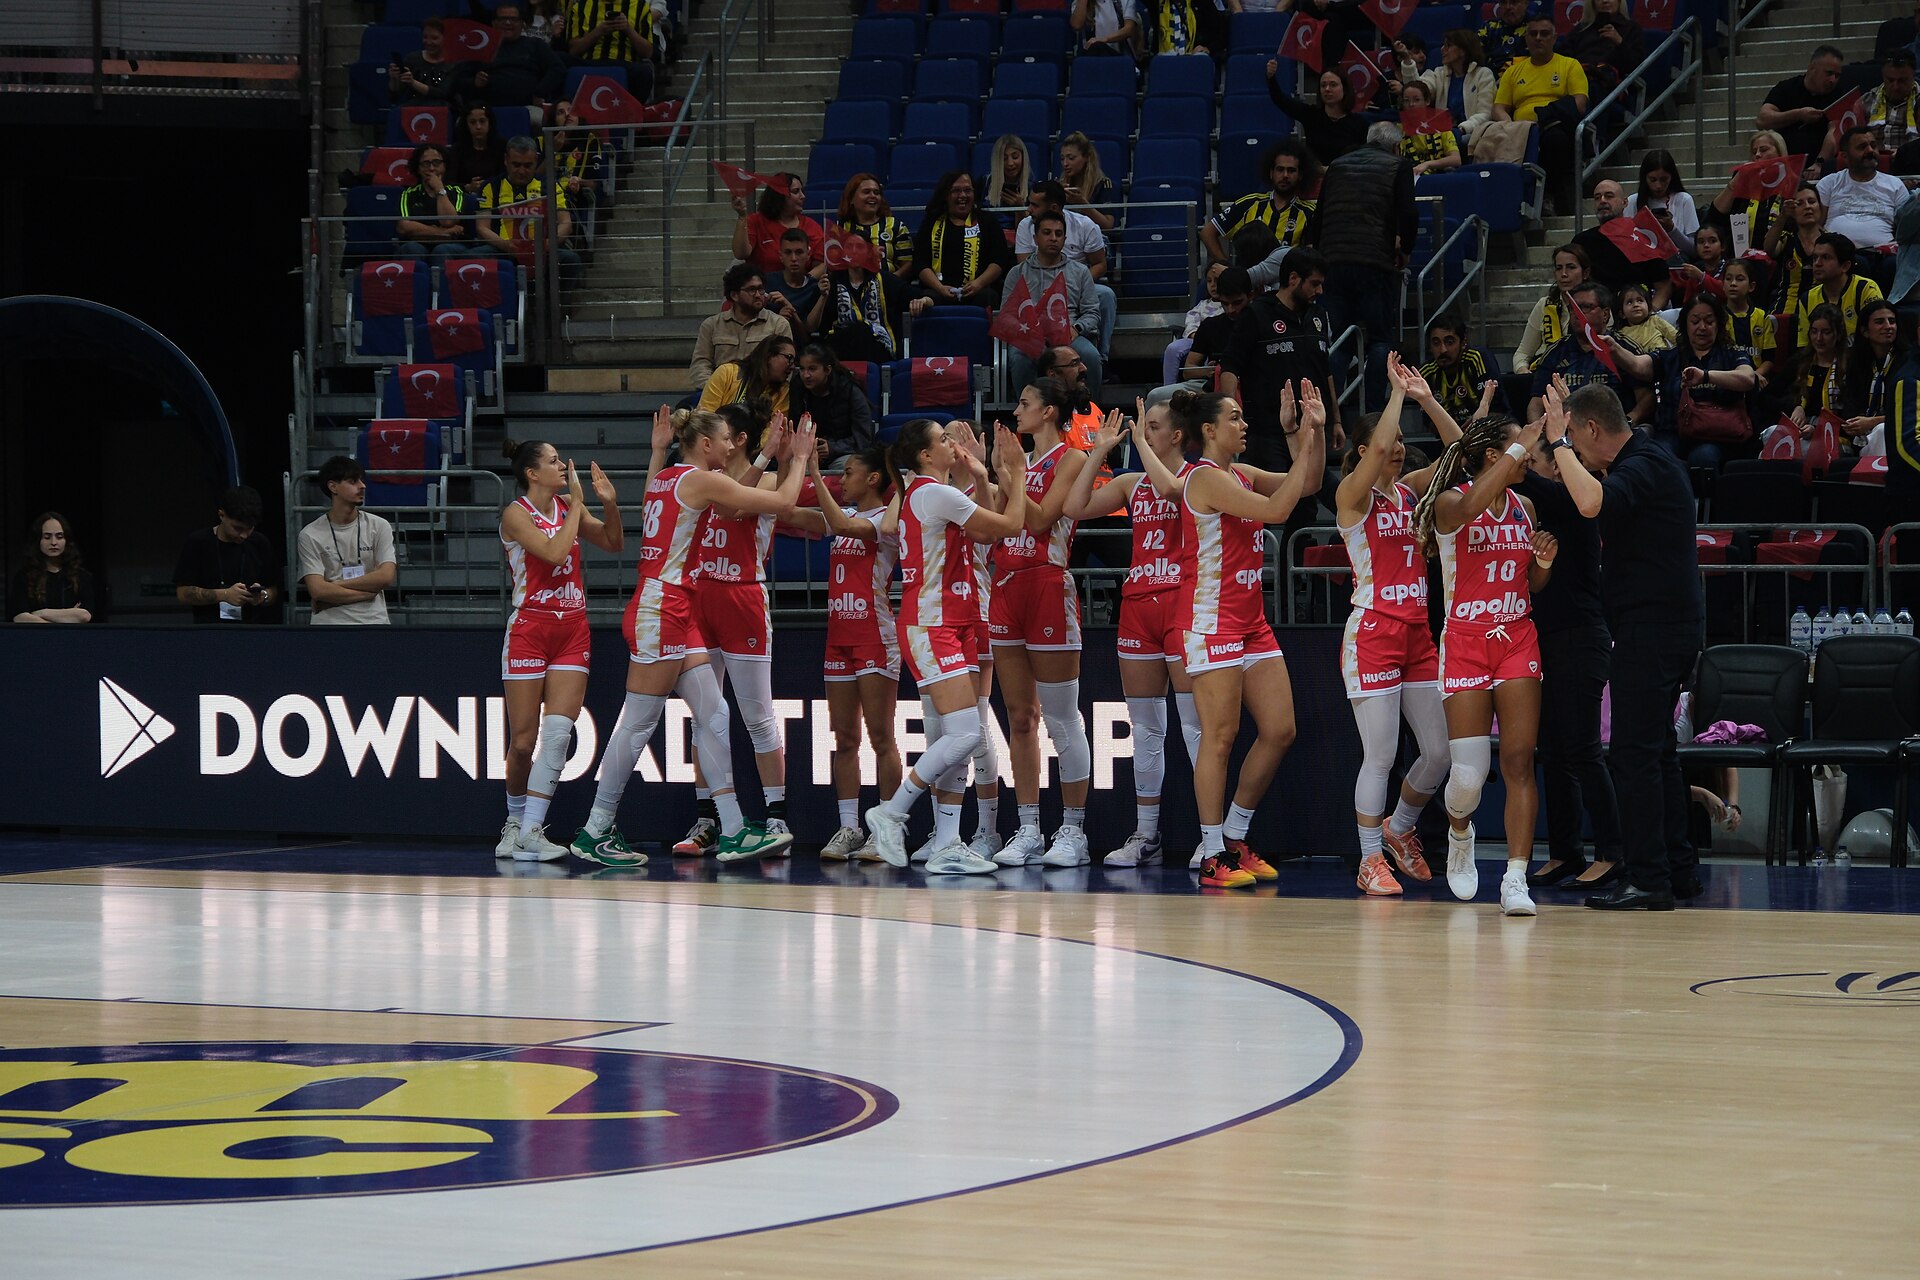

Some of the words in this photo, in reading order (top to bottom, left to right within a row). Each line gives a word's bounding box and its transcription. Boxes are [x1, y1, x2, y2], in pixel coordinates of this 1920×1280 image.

[1266, 341, 1294, 354] SPOR
[1132, 498, 1179, 517] DVTK
[643, 499, 664, 539] 18
[701, 527, 727, 549] 20
[1142, 528, 1165, 550] 42
[1252, 529, 1264, 553] 33
[1468, 524, 1530, 545] DVTK
[1402, 544, 1414, 568] 7
[836, 563, 845, 584] 0
[1485, 559, 1516, 583] 10
[838, 611, 868, 620] TYRES
[1455, 591, 1527, 621] apollo
[511, 658, 545, 668] HUGGIES
[1362, 668, 1401, 684] HUGGIES
[1446, 674, 1490, 688] HUGGIES
